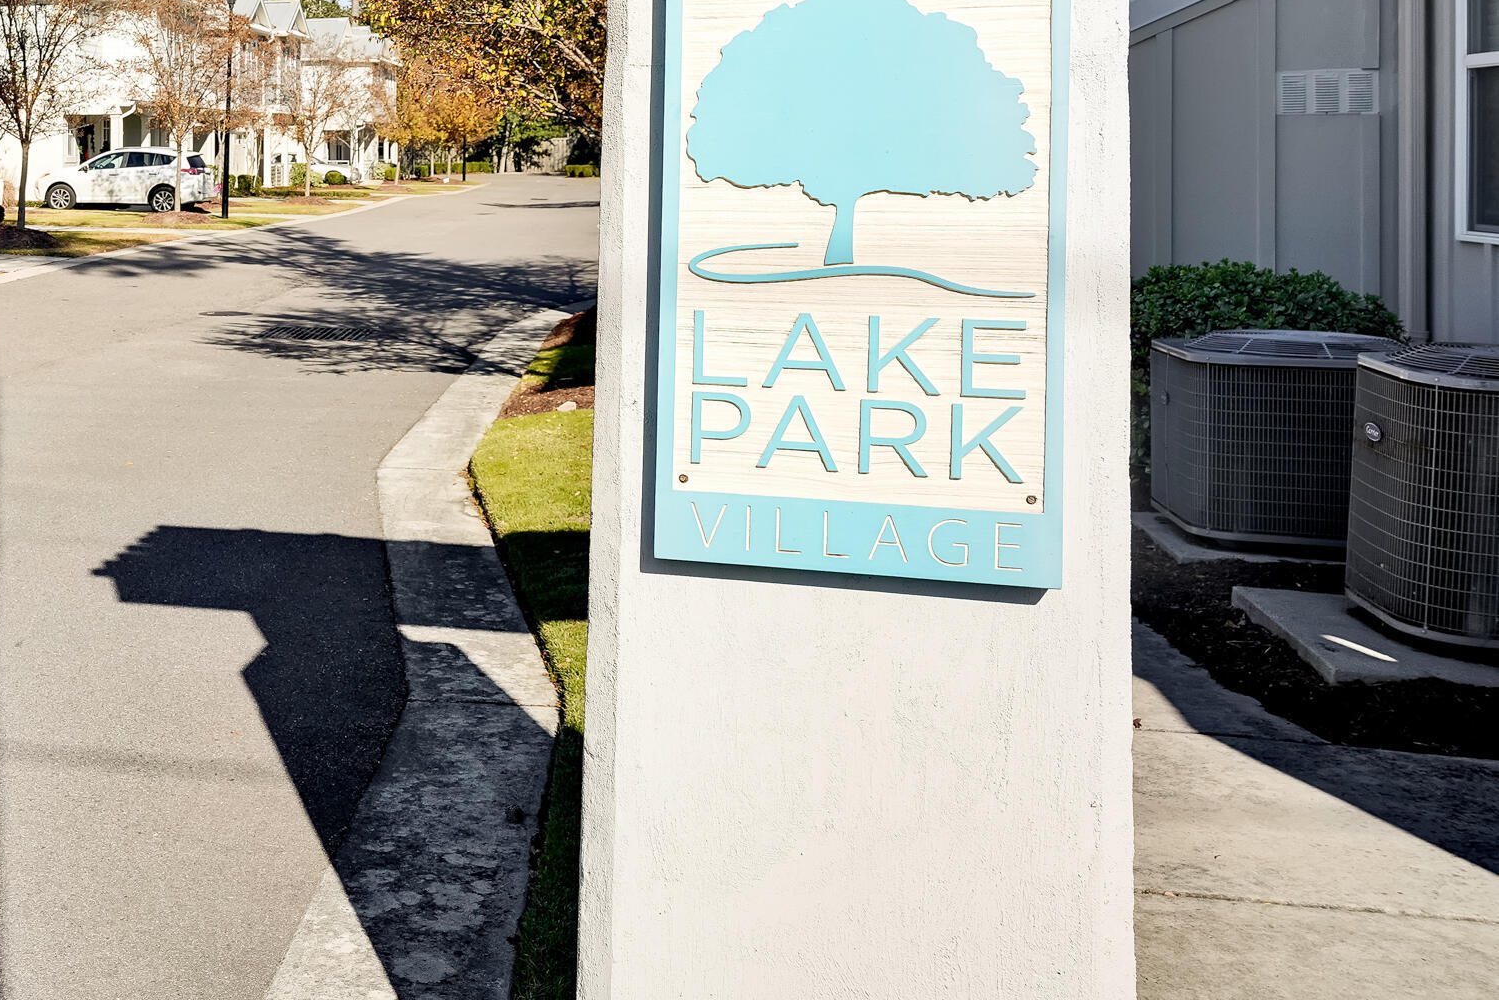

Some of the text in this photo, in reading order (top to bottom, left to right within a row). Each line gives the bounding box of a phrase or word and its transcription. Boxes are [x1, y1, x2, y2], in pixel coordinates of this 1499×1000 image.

[691, 309, 1027, 400] LAKE
[689, 390, 1025, 485] PARK
[690, 501, 1024, 572] VILLAGE
